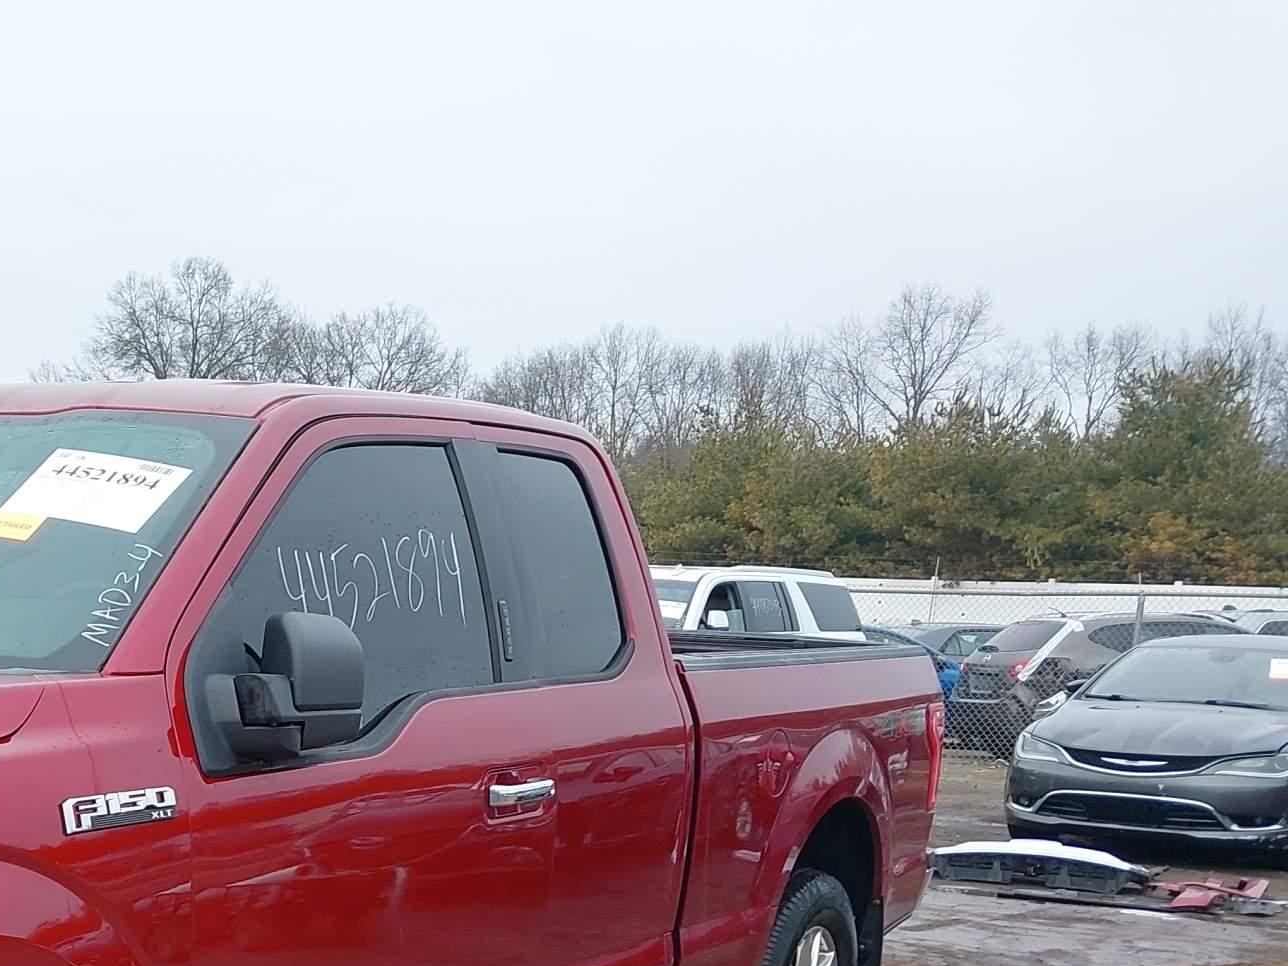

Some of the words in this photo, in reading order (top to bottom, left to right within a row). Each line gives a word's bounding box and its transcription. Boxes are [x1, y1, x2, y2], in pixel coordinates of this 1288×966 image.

[51, 463, 161, 491] 44521894
[277, 529, 466, 630] 44521894
[151, 808, 174, 820] XLT
